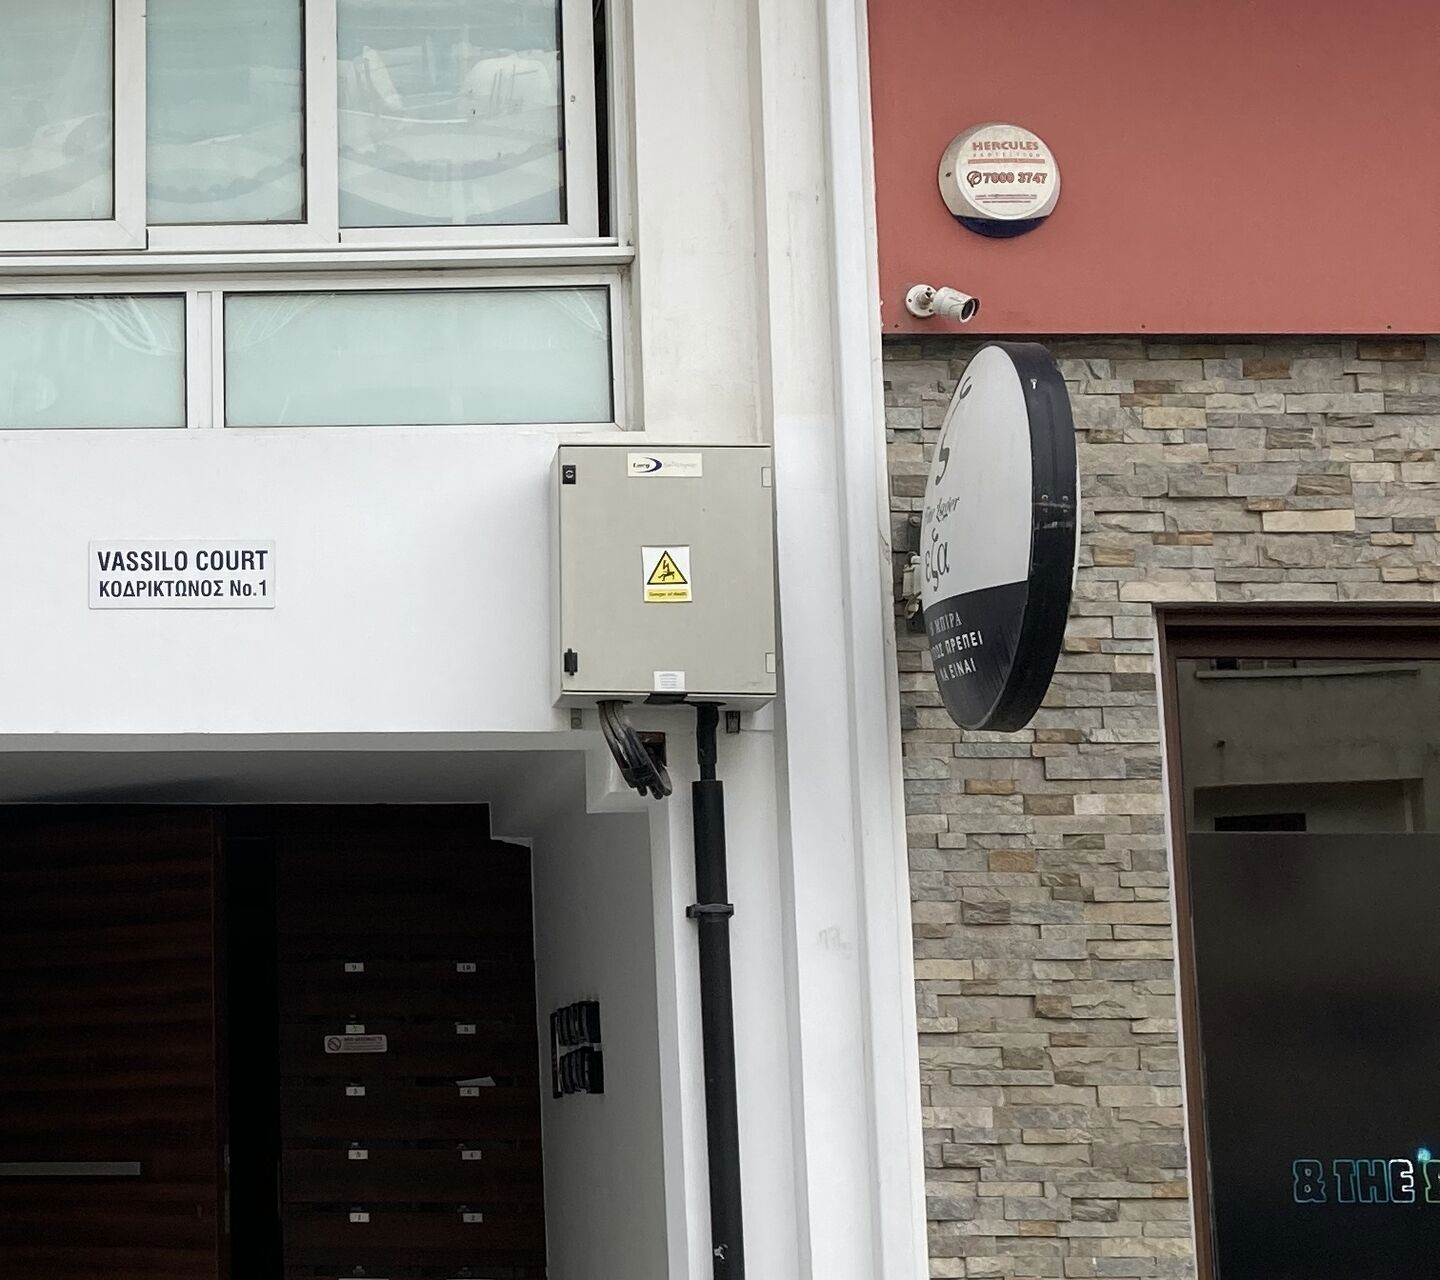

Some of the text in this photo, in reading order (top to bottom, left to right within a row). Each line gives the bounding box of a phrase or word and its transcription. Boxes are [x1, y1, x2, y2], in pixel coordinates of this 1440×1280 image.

[972, 141, 1039, 151] HERCULES
[1017, 172, 1048, 184] 3747
[97, 549, 268, 571] VASSILO COURT
[99, 579, 267, 598] ΚΟΔΡΙΚΤΩΝΟΣ No.1
[934, 611, 962, 634] ΜΠΙΡΑ
[944, 630, 983, 655] ΠΡΕΠΕΙ
[948, 657, 977, 679] ΕΙΝΑΙ
[1333, 1159, 1415, 1203] THE
